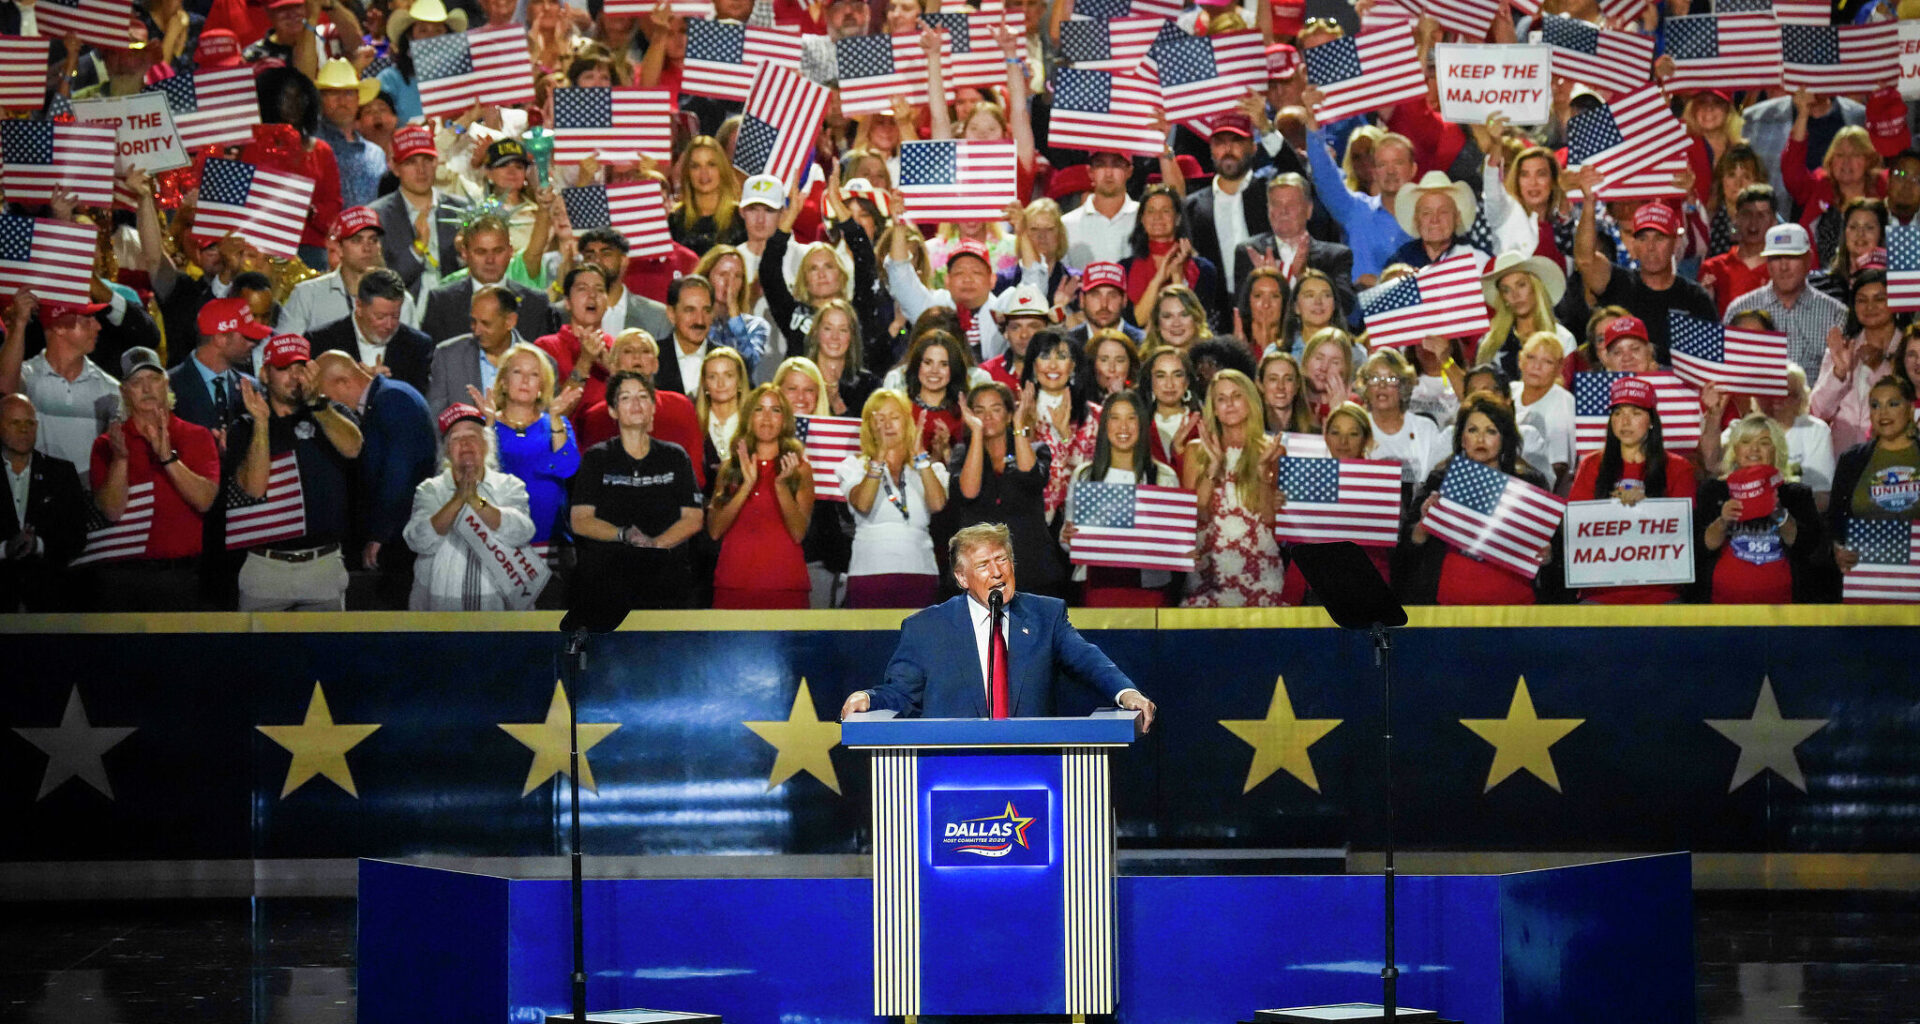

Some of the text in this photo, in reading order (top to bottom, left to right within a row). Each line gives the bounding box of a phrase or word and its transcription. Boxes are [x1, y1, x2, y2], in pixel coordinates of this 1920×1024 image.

[1448, 64, 1539, 78] KEEP THE
[1447, 88, 1542, 104] MAJORITY
[127, 112, 161, 130] THE
[114, 134, 173, 156] JORITY
[752, 181, 774, 192] 47
[1577, 518, 1680, 538] KEEP THE
[465, 515, 532, 597] MAJORITY
[1573, 544, 1685, 564] MAJORITY
[1748, 541, 1770, 553] 956
[513, 546, 539, 581] THE
[945, 823, 1013, 837] DALLAS
